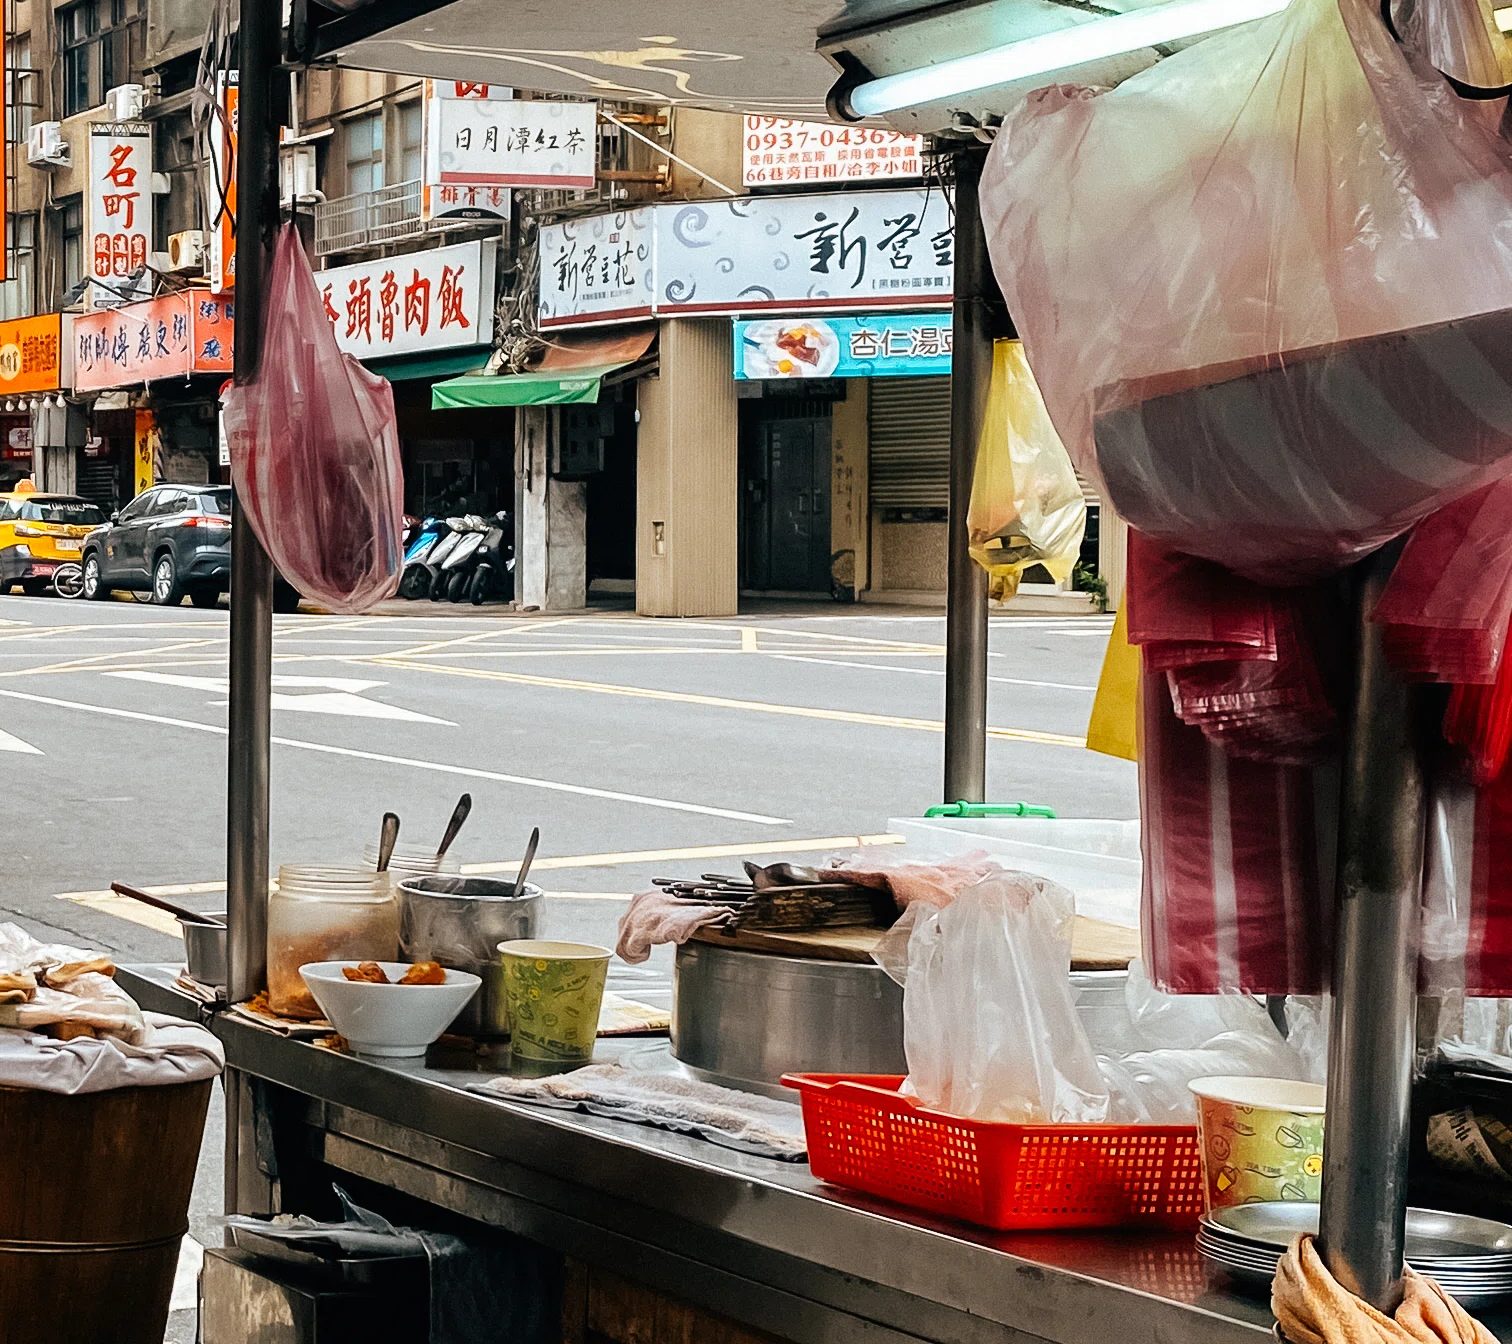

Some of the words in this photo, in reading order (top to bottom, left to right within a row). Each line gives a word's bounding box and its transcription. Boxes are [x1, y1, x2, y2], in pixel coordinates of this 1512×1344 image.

[455, 125, 586, 156] 日月潭紅茶
